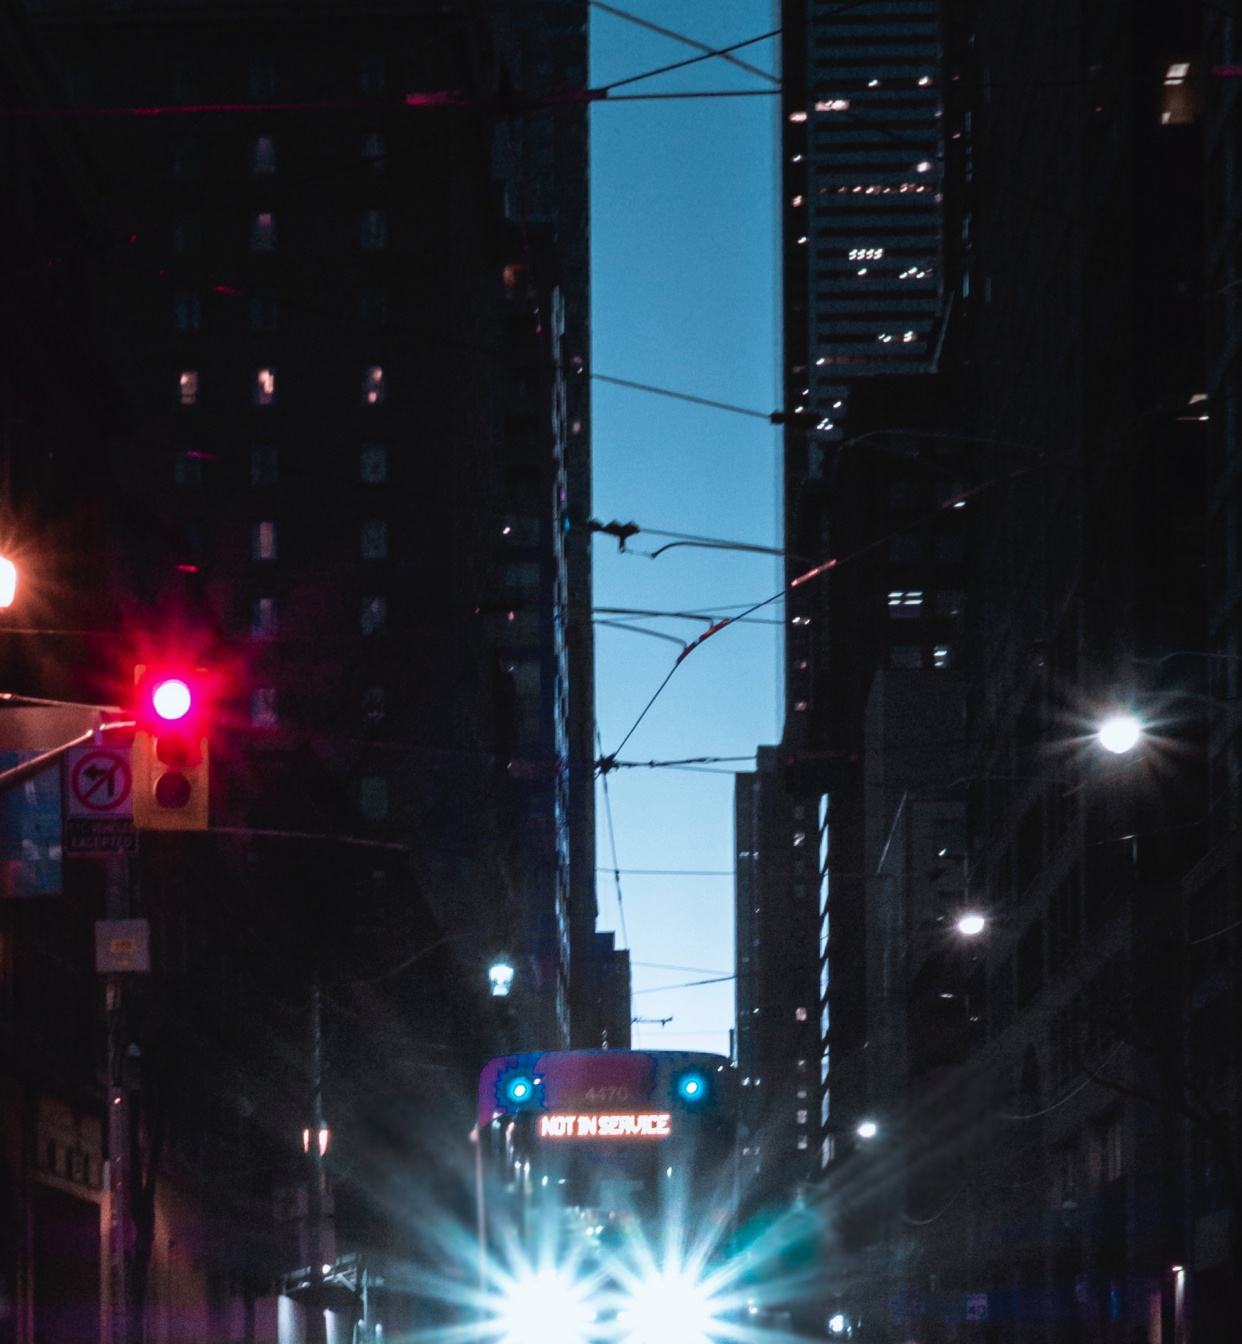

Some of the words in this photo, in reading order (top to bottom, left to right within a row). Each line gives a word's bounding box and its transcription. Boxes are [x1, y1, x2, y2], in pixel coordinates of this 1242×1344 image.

[585, 1086, 629, 1101] 4470
[541, 1115, 577, 1137] NOT
[577, 1115, 597, 1136] IN
[598, 1114, 670, 1136] SERVICE
